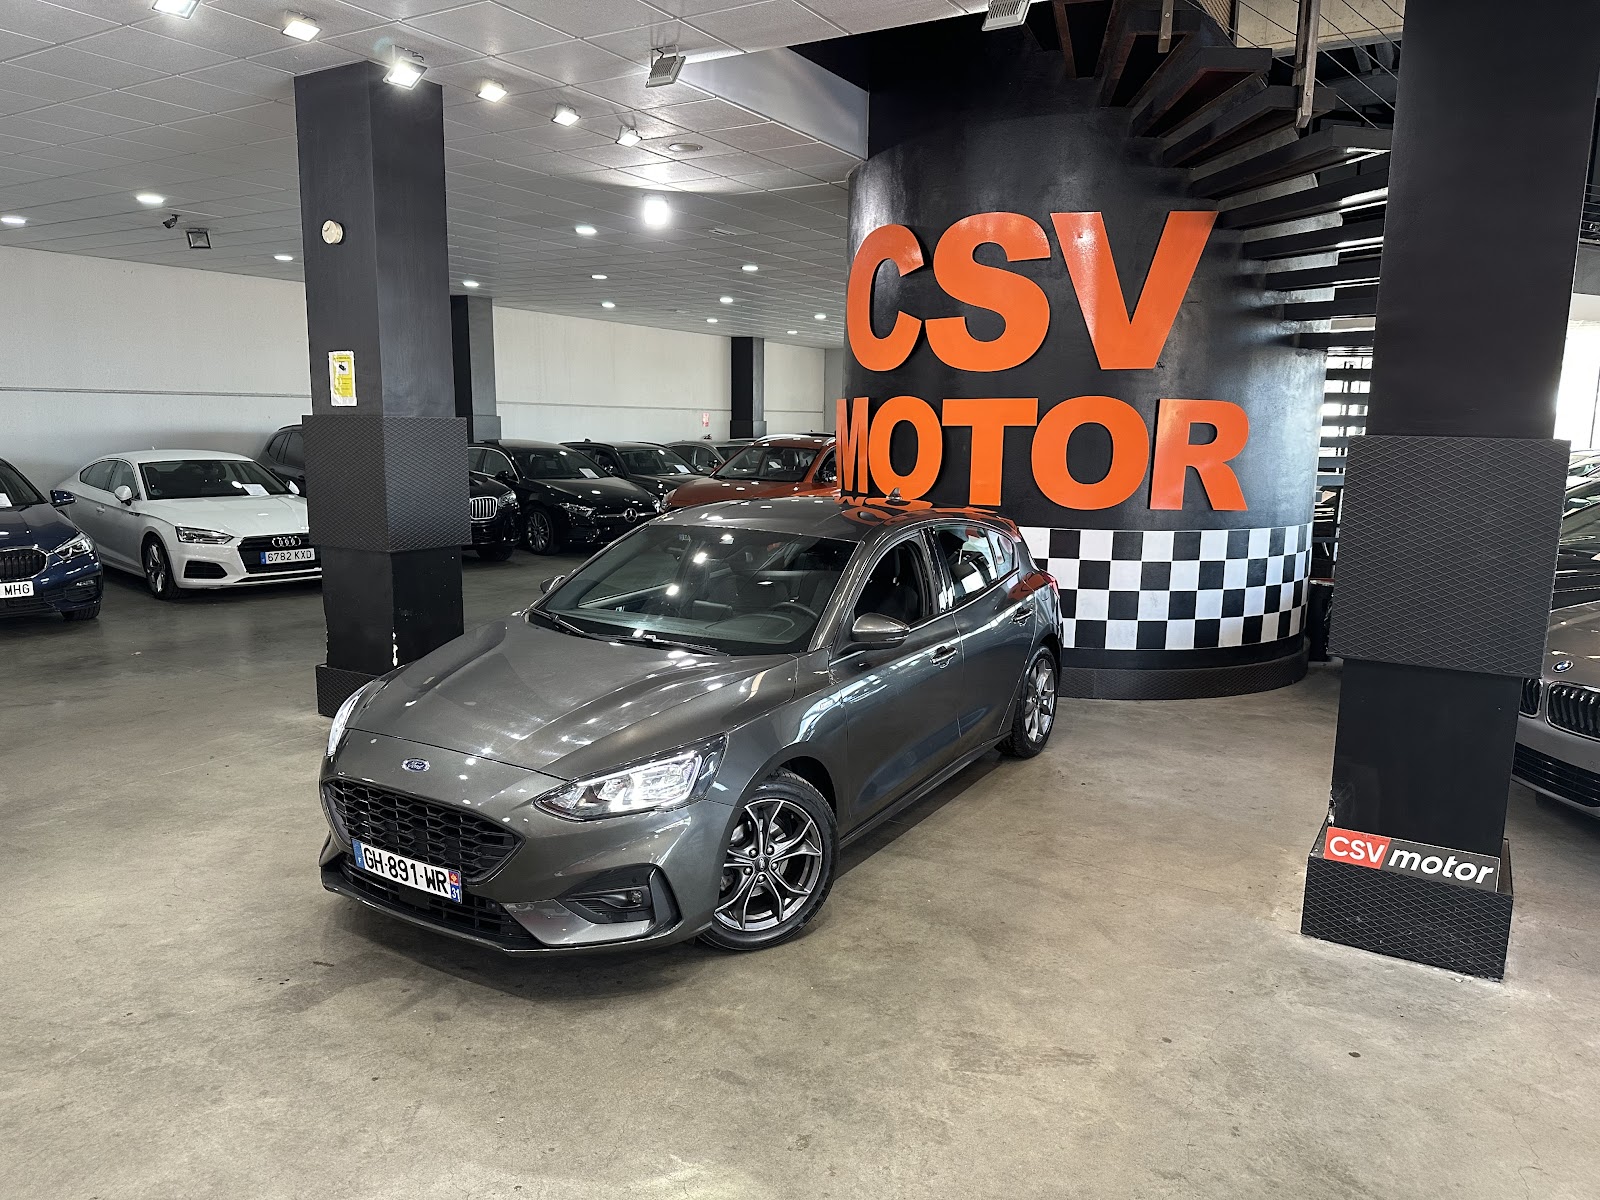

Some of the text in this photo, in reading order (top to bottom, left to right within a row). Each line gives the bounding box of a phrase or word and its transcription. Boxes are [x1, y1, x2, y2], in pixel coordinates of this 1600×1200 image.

[847, 210, 1219, 372] CSV
[835, 396, 1249, 511] MOTOR
[267, 550, 312, 561] 6782 KXD
[4, 583, 30, 596] MHG
[363, 847, 449, 895] GH-891-WR
[1329, 836, 1495, 884] CSV motor
[451, 887, 460, 900] 31
